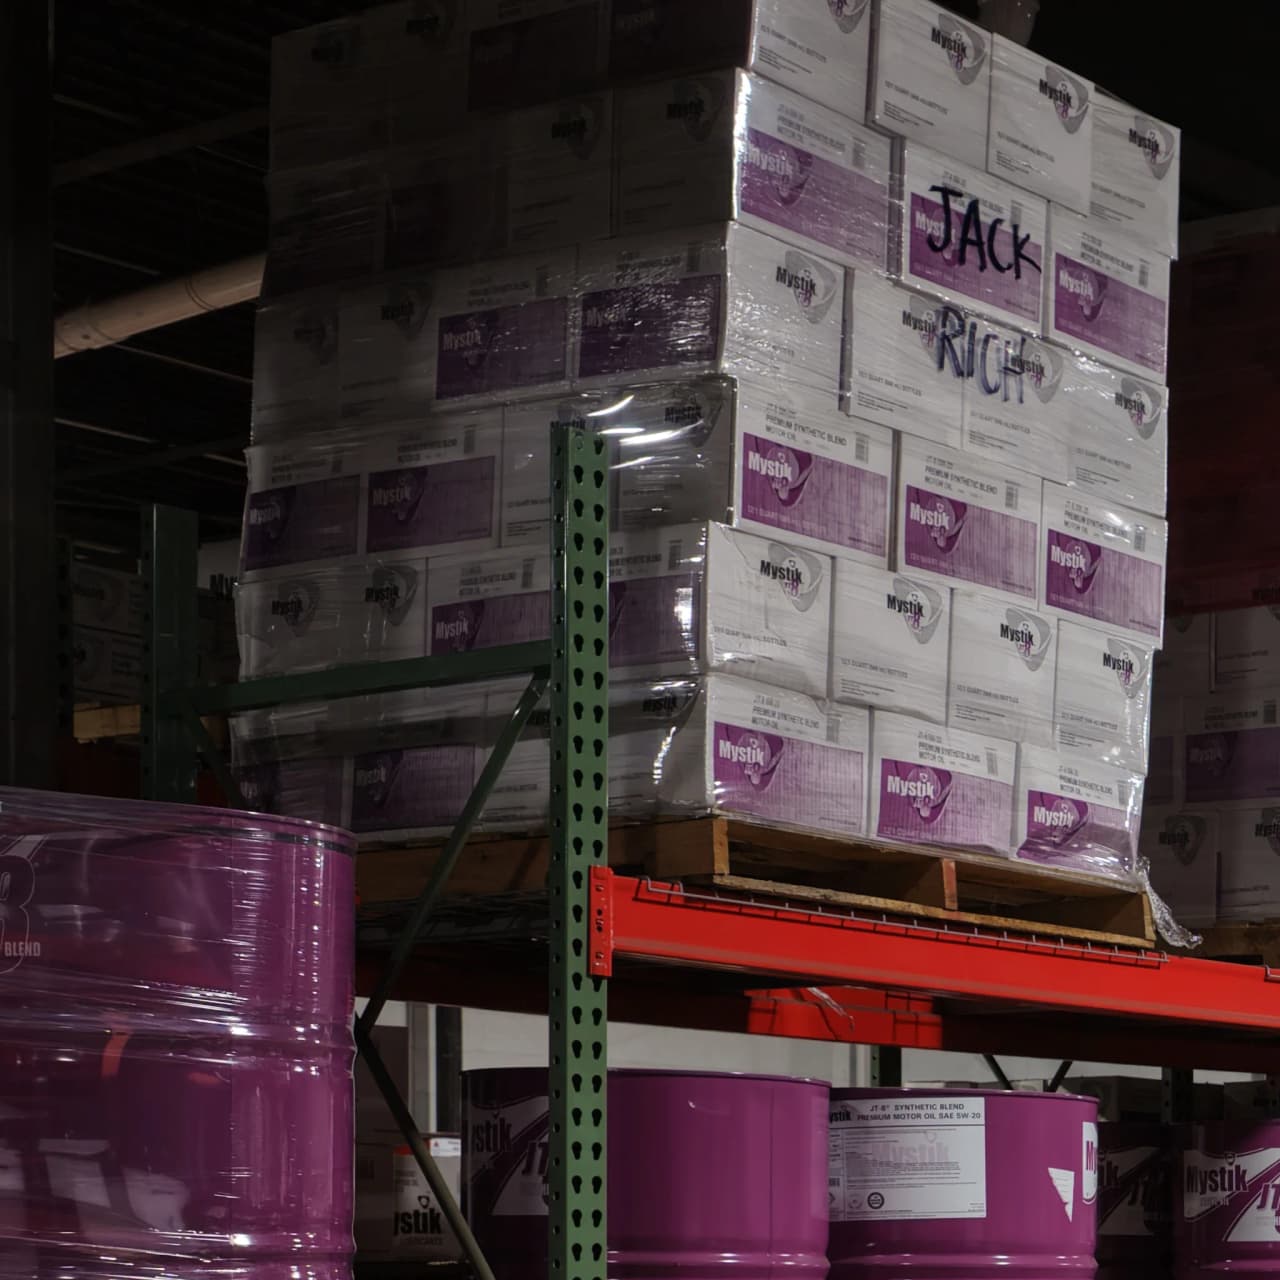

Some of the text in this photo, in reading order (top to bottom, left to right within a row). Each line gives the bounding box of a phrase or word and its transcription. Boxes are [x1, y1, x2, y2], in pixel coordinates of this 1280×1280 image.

[931, 27, 968, 58] Mystik
[1039, 77, 1073, 106] Mystik
[1129, 127, 1160, 155] Mystik
[746, 140, 796, 178] Mystik
[928, 185, 1041, 280] JACK
[776, 265, 817, 297] Mystik
[1059, 269, 1095, 301] Mystik
[937, 304, 1027, 404] RICH
[1114, 391, 1147, 416] Mystik
[748, 450, 793, 483] Mystik
[910, 501, 950, 530] Mystik
[759, 558, 805, 585] Mystik
[1051, 545, 1086, 571] Mystik
[887, 592, 924, 619] Mystik
[1000, 622, 1035, 649] Mystik
[1102, 649, 1135, 676] Mystik
[719, 739, 765, 767] Mystik
[887, 774, 934, 799] Mystik
[1033, 805, 1075, 828] Mystik
[4, 941, 41, 957] BLEND
[857, 1113, 891, 1122] PREMIUM
[893, 1112, 922, 1121] MOTOR
[923, 1112, 937, 1120] OIL
[938, 1112, 954, 1120] SAE
[894, 1102, 965, 1111] SYNTHETIC BLEND
[1186, 1162, 1250, 1194] Mystik
